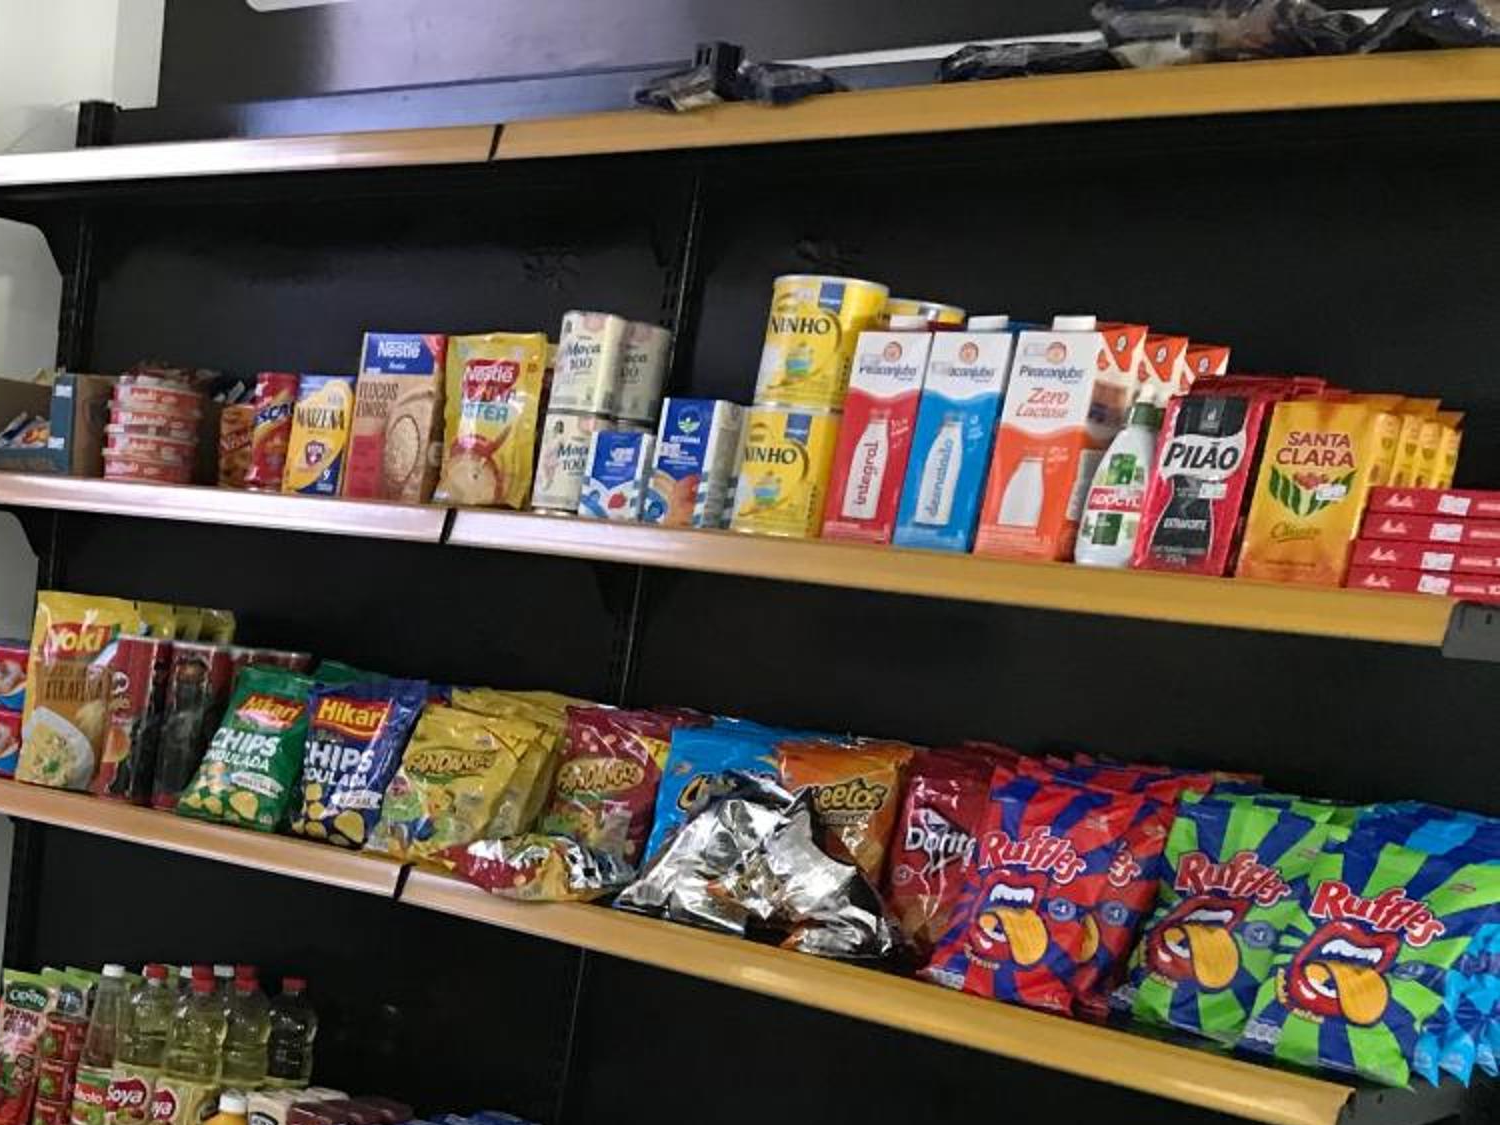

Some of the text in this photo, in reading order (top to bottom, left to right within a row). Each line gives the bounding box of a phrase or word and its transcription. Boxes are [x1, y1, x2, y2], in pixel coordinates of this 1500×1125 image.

[1028, 387, 1070, 405] Zero
[1163, 441, 1240, 470] PILÃO
[1287, 431, 1351, 450] SANTA
[1276, 448, 1355, 467] CLARA
[853, 440, 880, 506] integral
[49, 626, 106, 651] Yoki
[239, 695, 305, 722] Hikari
[316, 698, 390, 729] Hikari
[211, 727, 281, 758] CHIPS
[305, 740, 375, 771] HIPS
[304, 766, 368, 787] DULADA
[806, 778, 889, 812] eetos
[978, 825, 1087, 885] Ruffles
[1174, 850, 1292, 908] Ruffles
[1308, 879, 1447, 949] Ruffles
[107, 1082, 144, 1106] Soya
